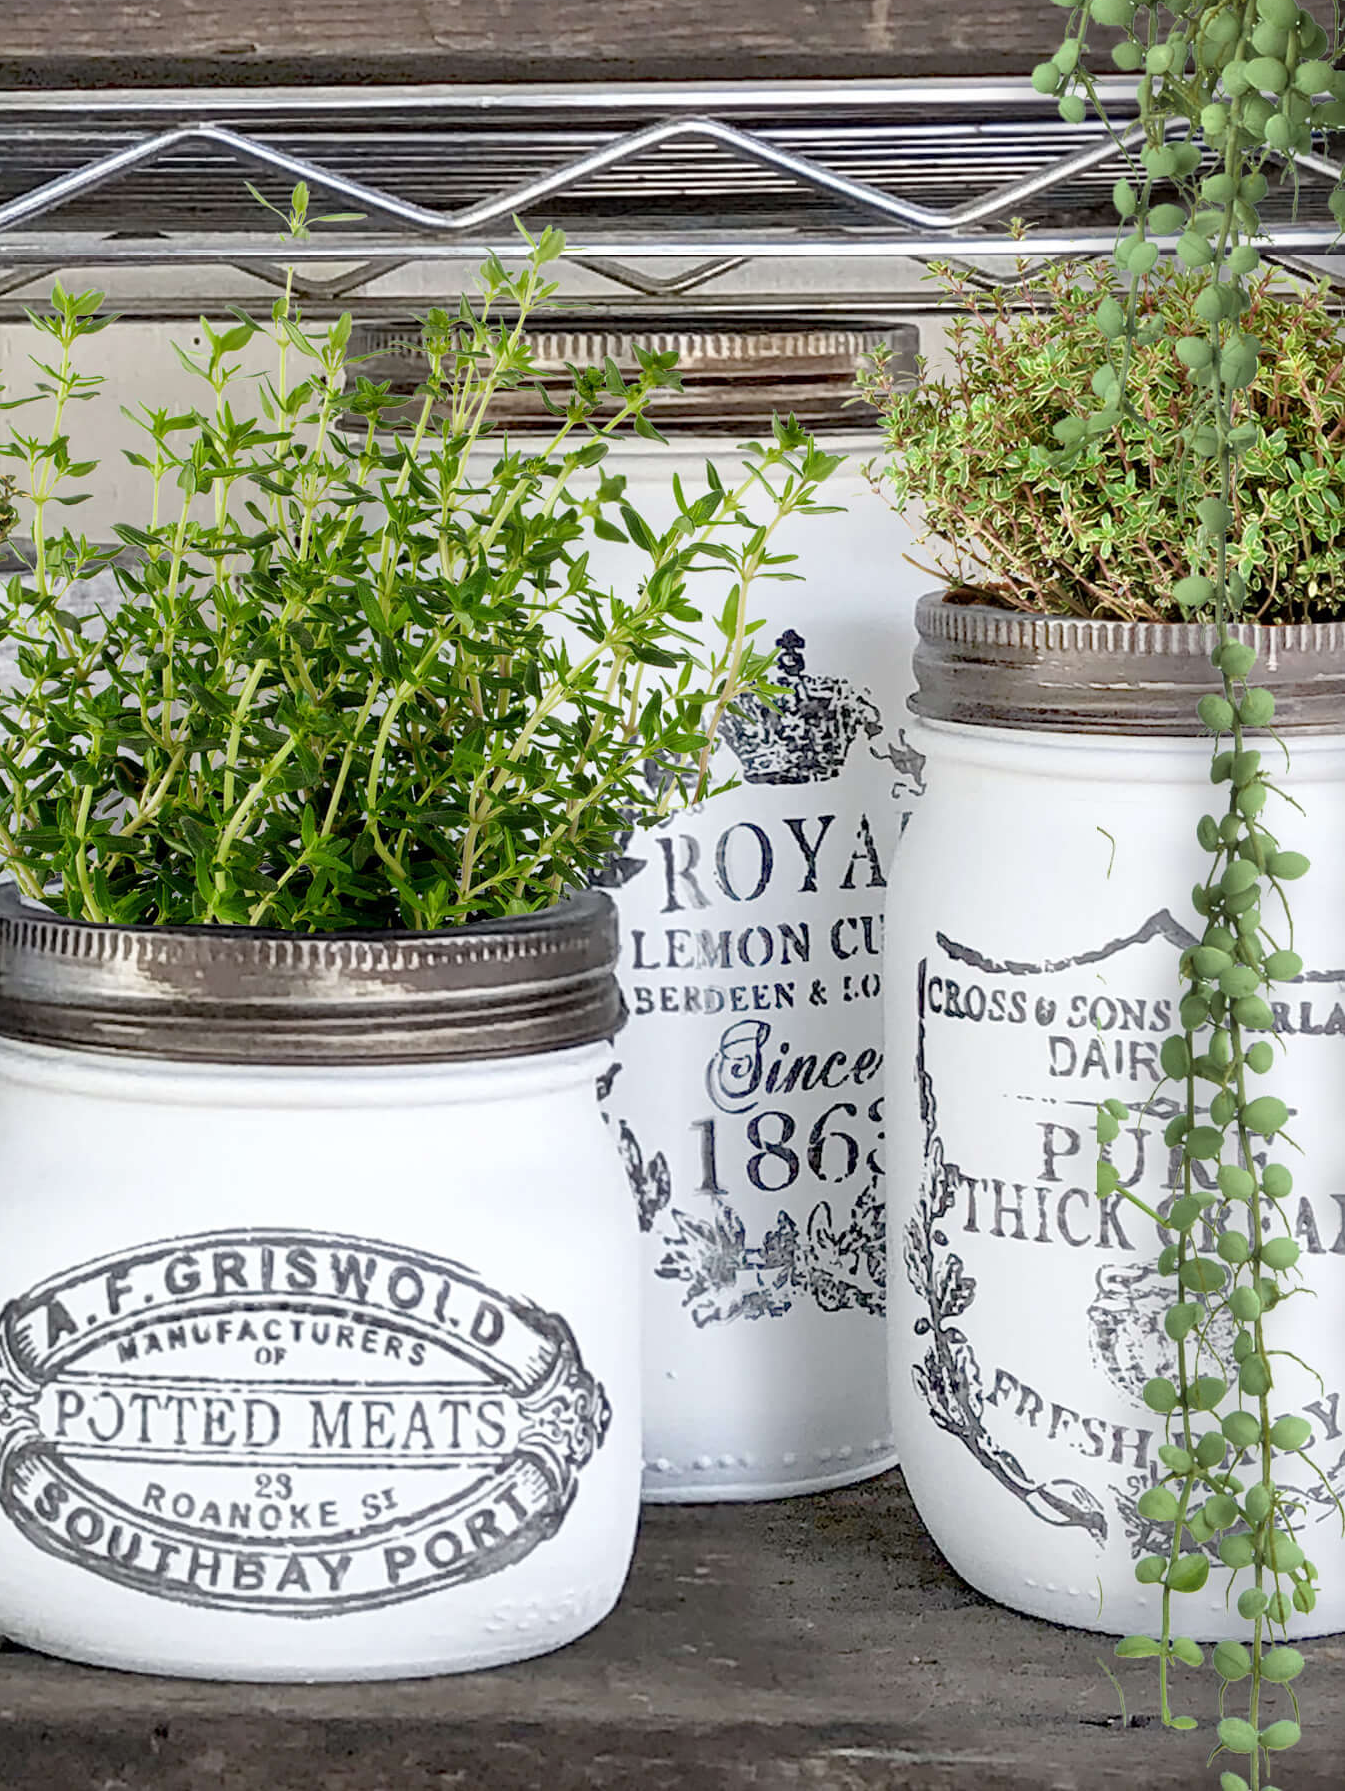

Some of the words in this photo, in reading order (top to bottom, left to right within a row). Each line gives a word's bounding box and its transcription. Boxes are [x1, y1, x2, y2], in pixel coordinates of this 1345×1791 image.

[630, 920, 811, 969] LEMON
[926, 974, 1027, 1027] CROSS
[1065, 994, 1172, 1033] SONS
[950, 1174, 1136, 1251] THICK
[117, 1317, 427, 1367] MANUFACTURERS
[253, 1345, 287, 1367] OF
[54, 1389, 281, 1448] POTTED
[308, 1399, 507, 1450] MEATS
[142, 1481, 339, 1531] ROANOKE
[254, 1472, 294, 1501] 23
[31, 1481, 354, 1595] SOUTHBAY
[383, 1483, 532, 1587] PORT
